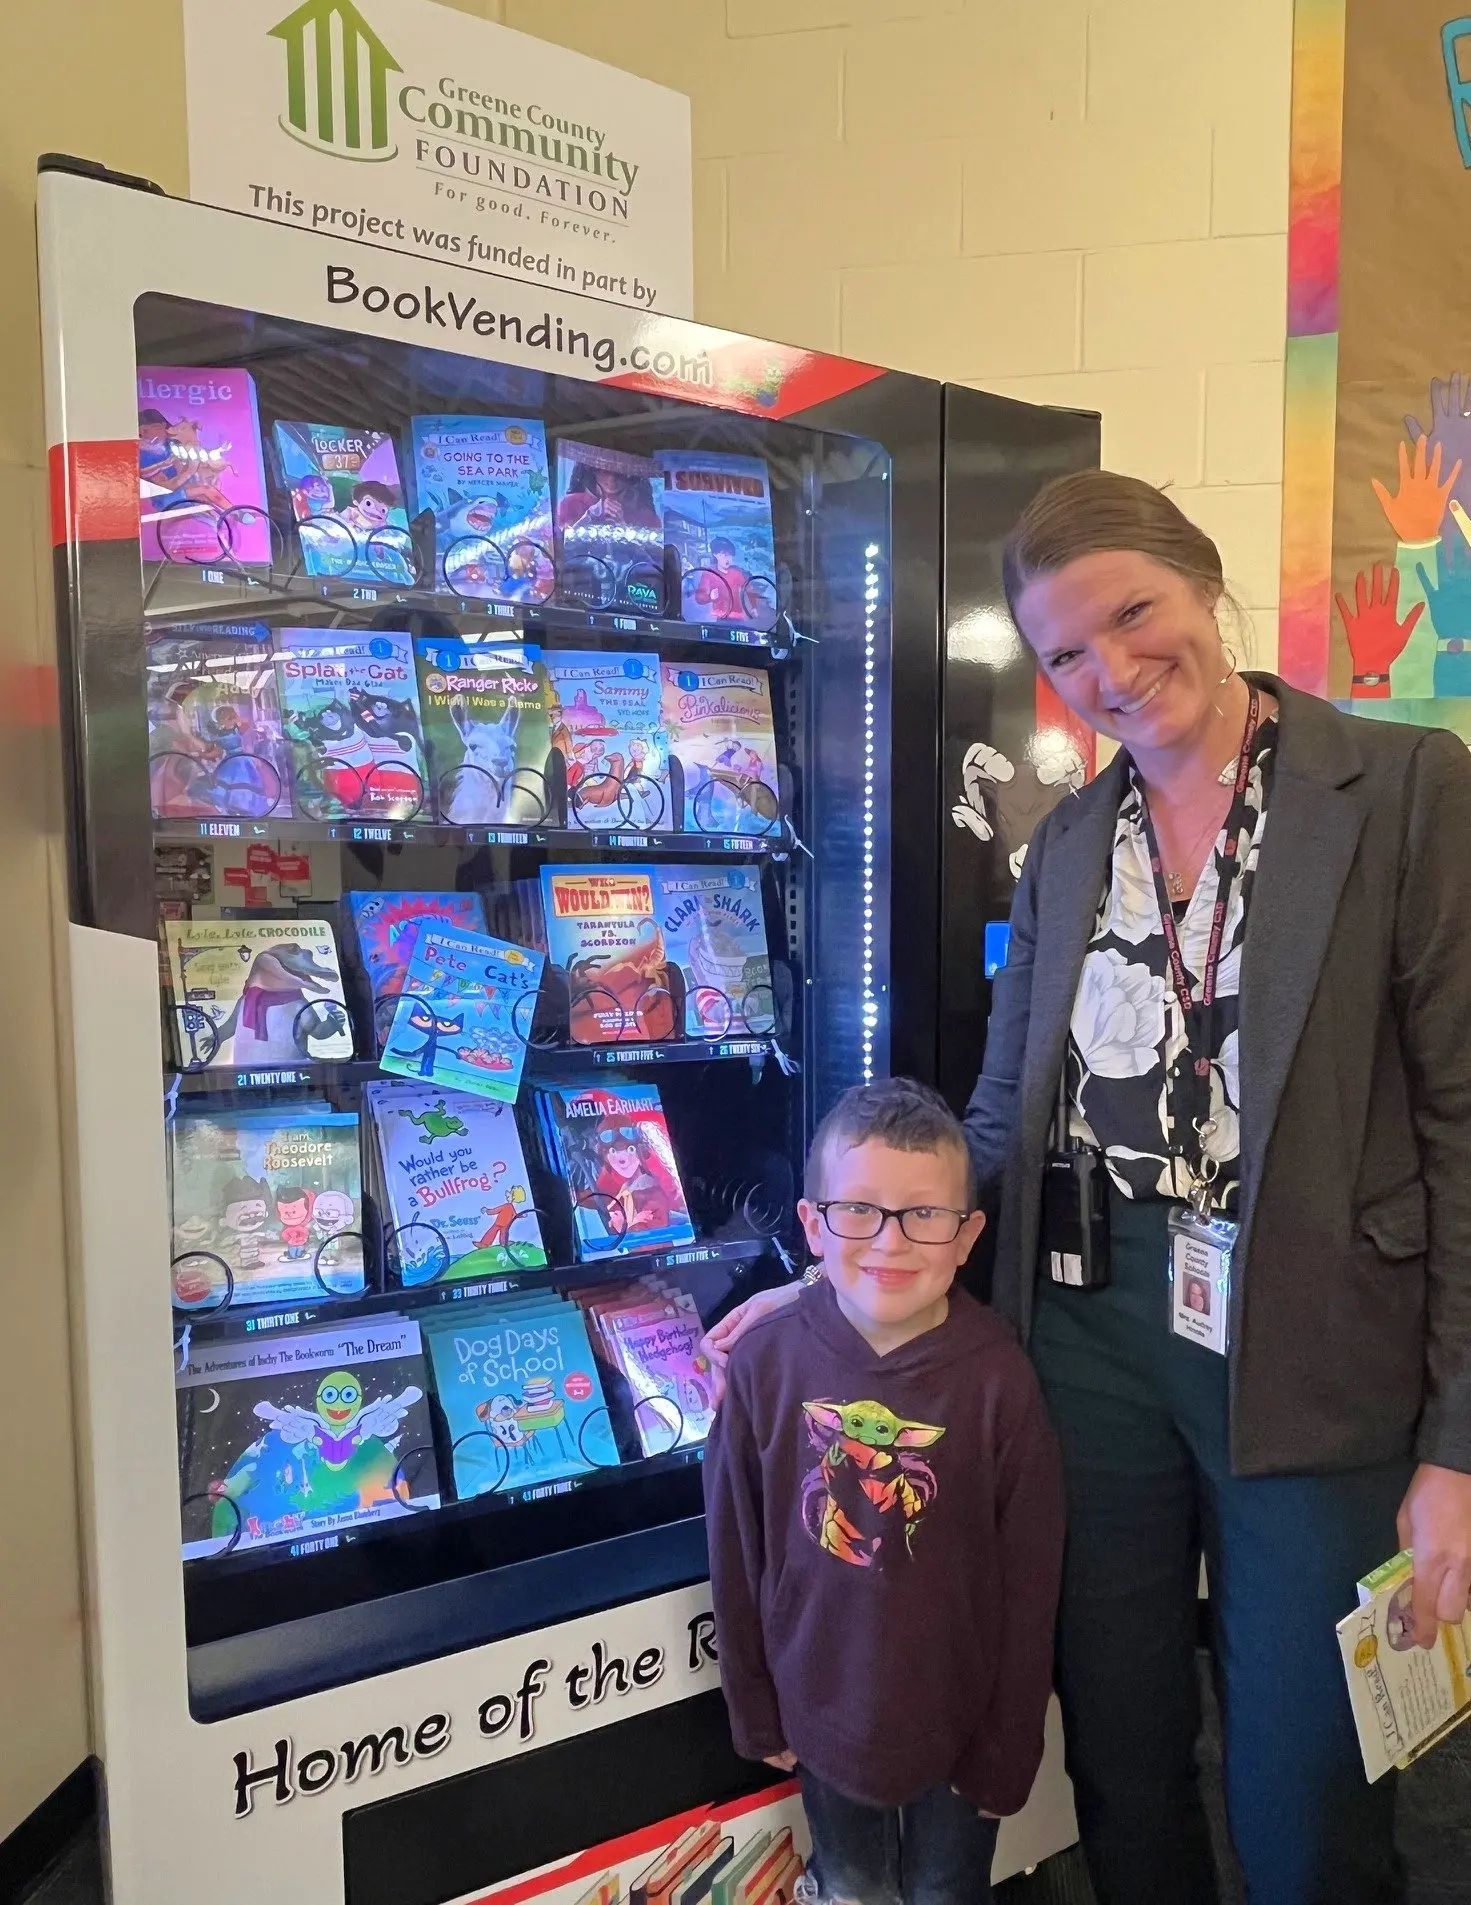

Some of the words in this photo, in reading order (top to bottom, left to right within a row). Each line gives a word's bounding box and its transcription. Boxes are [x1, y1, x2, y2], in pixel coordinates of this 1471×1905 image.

[438, 77, 521, 119] Greene
[526, 103, 606, 148] County
[398, 85, 640, 195] Community
[415, 138, 630, 220] FOUNDATION
[434, 181, 468, 203] For
[476, 195, 530, 221] good.
[540, 210, 616, 244] Forever.
[249, 184, 304, 218] This
[313, 205, 405, 238] project
[412, 223, 461, 252] was
[467, 235, 550, 275] funded
[556, 257, 577, 281] in
[582, 264, 625, 295] part
[632, 276, 657, 307] by
[326, 265, 714, 385] BookVending.com
[140, 379, 232, 405] llergic
[314, 438, 367, 459] LOCKER
[335, 455, 349, 469] 37
[444, 453, 482, 462] GOING
[486, 453, 503, 463] TO
[507, 454, 530, 465] THE
[458, 466, 484, 476] SEA
[487, 467, 519, 478] PARK
[353, 588, 360, 600] 2
[361, 588, 377, 601] TWO
[487, 605, 493, 615] 3
[212, 624, 255, 636] READING
[446, 654, 452, 667] 1
[285, 661, 347, 679] Spla
[368, 664, 408, 680] Cat
[570, 669, 591, 678] Can
[446, 675, 500, 692] Ranger
[502, 677, 533, 694] Rick
[594, 680, 649, 699] Sammy
[707, 676, 727, 686] Can
[472, 696, 496, 707] Was
[499, 699, 506, 707] a
[208, 823, 241, 837] ELEVEN
[353, 828, 364, 839] 12
[364, 828, 392, 841] TWELVE
[555, 886, 610, 914] WOULD
[713, 893, 760, 932] SHARK
[258, 926, 326, 938] CROCODILE
[577, 920, 635, 930] TARANTULA
[1207, 924, 1220, 963] County
[425, 946, 467, 970] Pete
[484, 965, 529, 989] Cat's
[1171, 950, 1186, 986] County
[1181, 988, 1192, 1010] CSD
[1203, 965, 1214, 1006] Greene
[237, 1074, 247, 1086] 21
[250, 1073, 280, 1085] TWENTY
[281, 1071, 296, 1083] ONE
[565, 1101, 606, 1119] AMELIA
[607, 1097, 654, 1115] EARHART
[264, 1140, 332, 1156] Theodore
[263, 1154, 334, 1170] Roosevelt
[398, 1151, 444, 1174] Would
[449, 1146, 473, 1162] you
[409, 1163, 455, 1186] rather
[460, 1160, 478, 1173] be
[408, 1196, 418, 1207] a
[416, 1161, 507, 1208] Bullfrog?
[449, 1215, 481, 1227] Seuss
[1185, 1253, 1209, 1268] County
[246, 1319, 255, 1331] 31
[257, 1313, 285, 1329] THIRTY
[284, 1312, 299, 1325] ONE
[454, 1335, 502, 1365] Dog
[505, 1326, 560, 1353] Days
[624, 1335, 656, 1349] Happy
[656, 1324, 699, 1343] Birthday
[188, 1364, 201, 1376] The
[204, 1358, 247, 1373] Adventures
[278, 1351, 292, 1363] The
[294, 1347, 334, 1361] Bookworm
[459, 1366, 478, 1385] of
[483, 1350, 564, 1388] School
[311, 1519, 326, 1529] Story
[327, 1517, 335, 1526] By
[291, 1544, 299, 1556] 41
[300, 1538, 324, 1555] FORTY
[233, 1709, 450, 1818] Home
[478, 1658, 552, 1742] of
[565, 1641, 664, 1709] the
